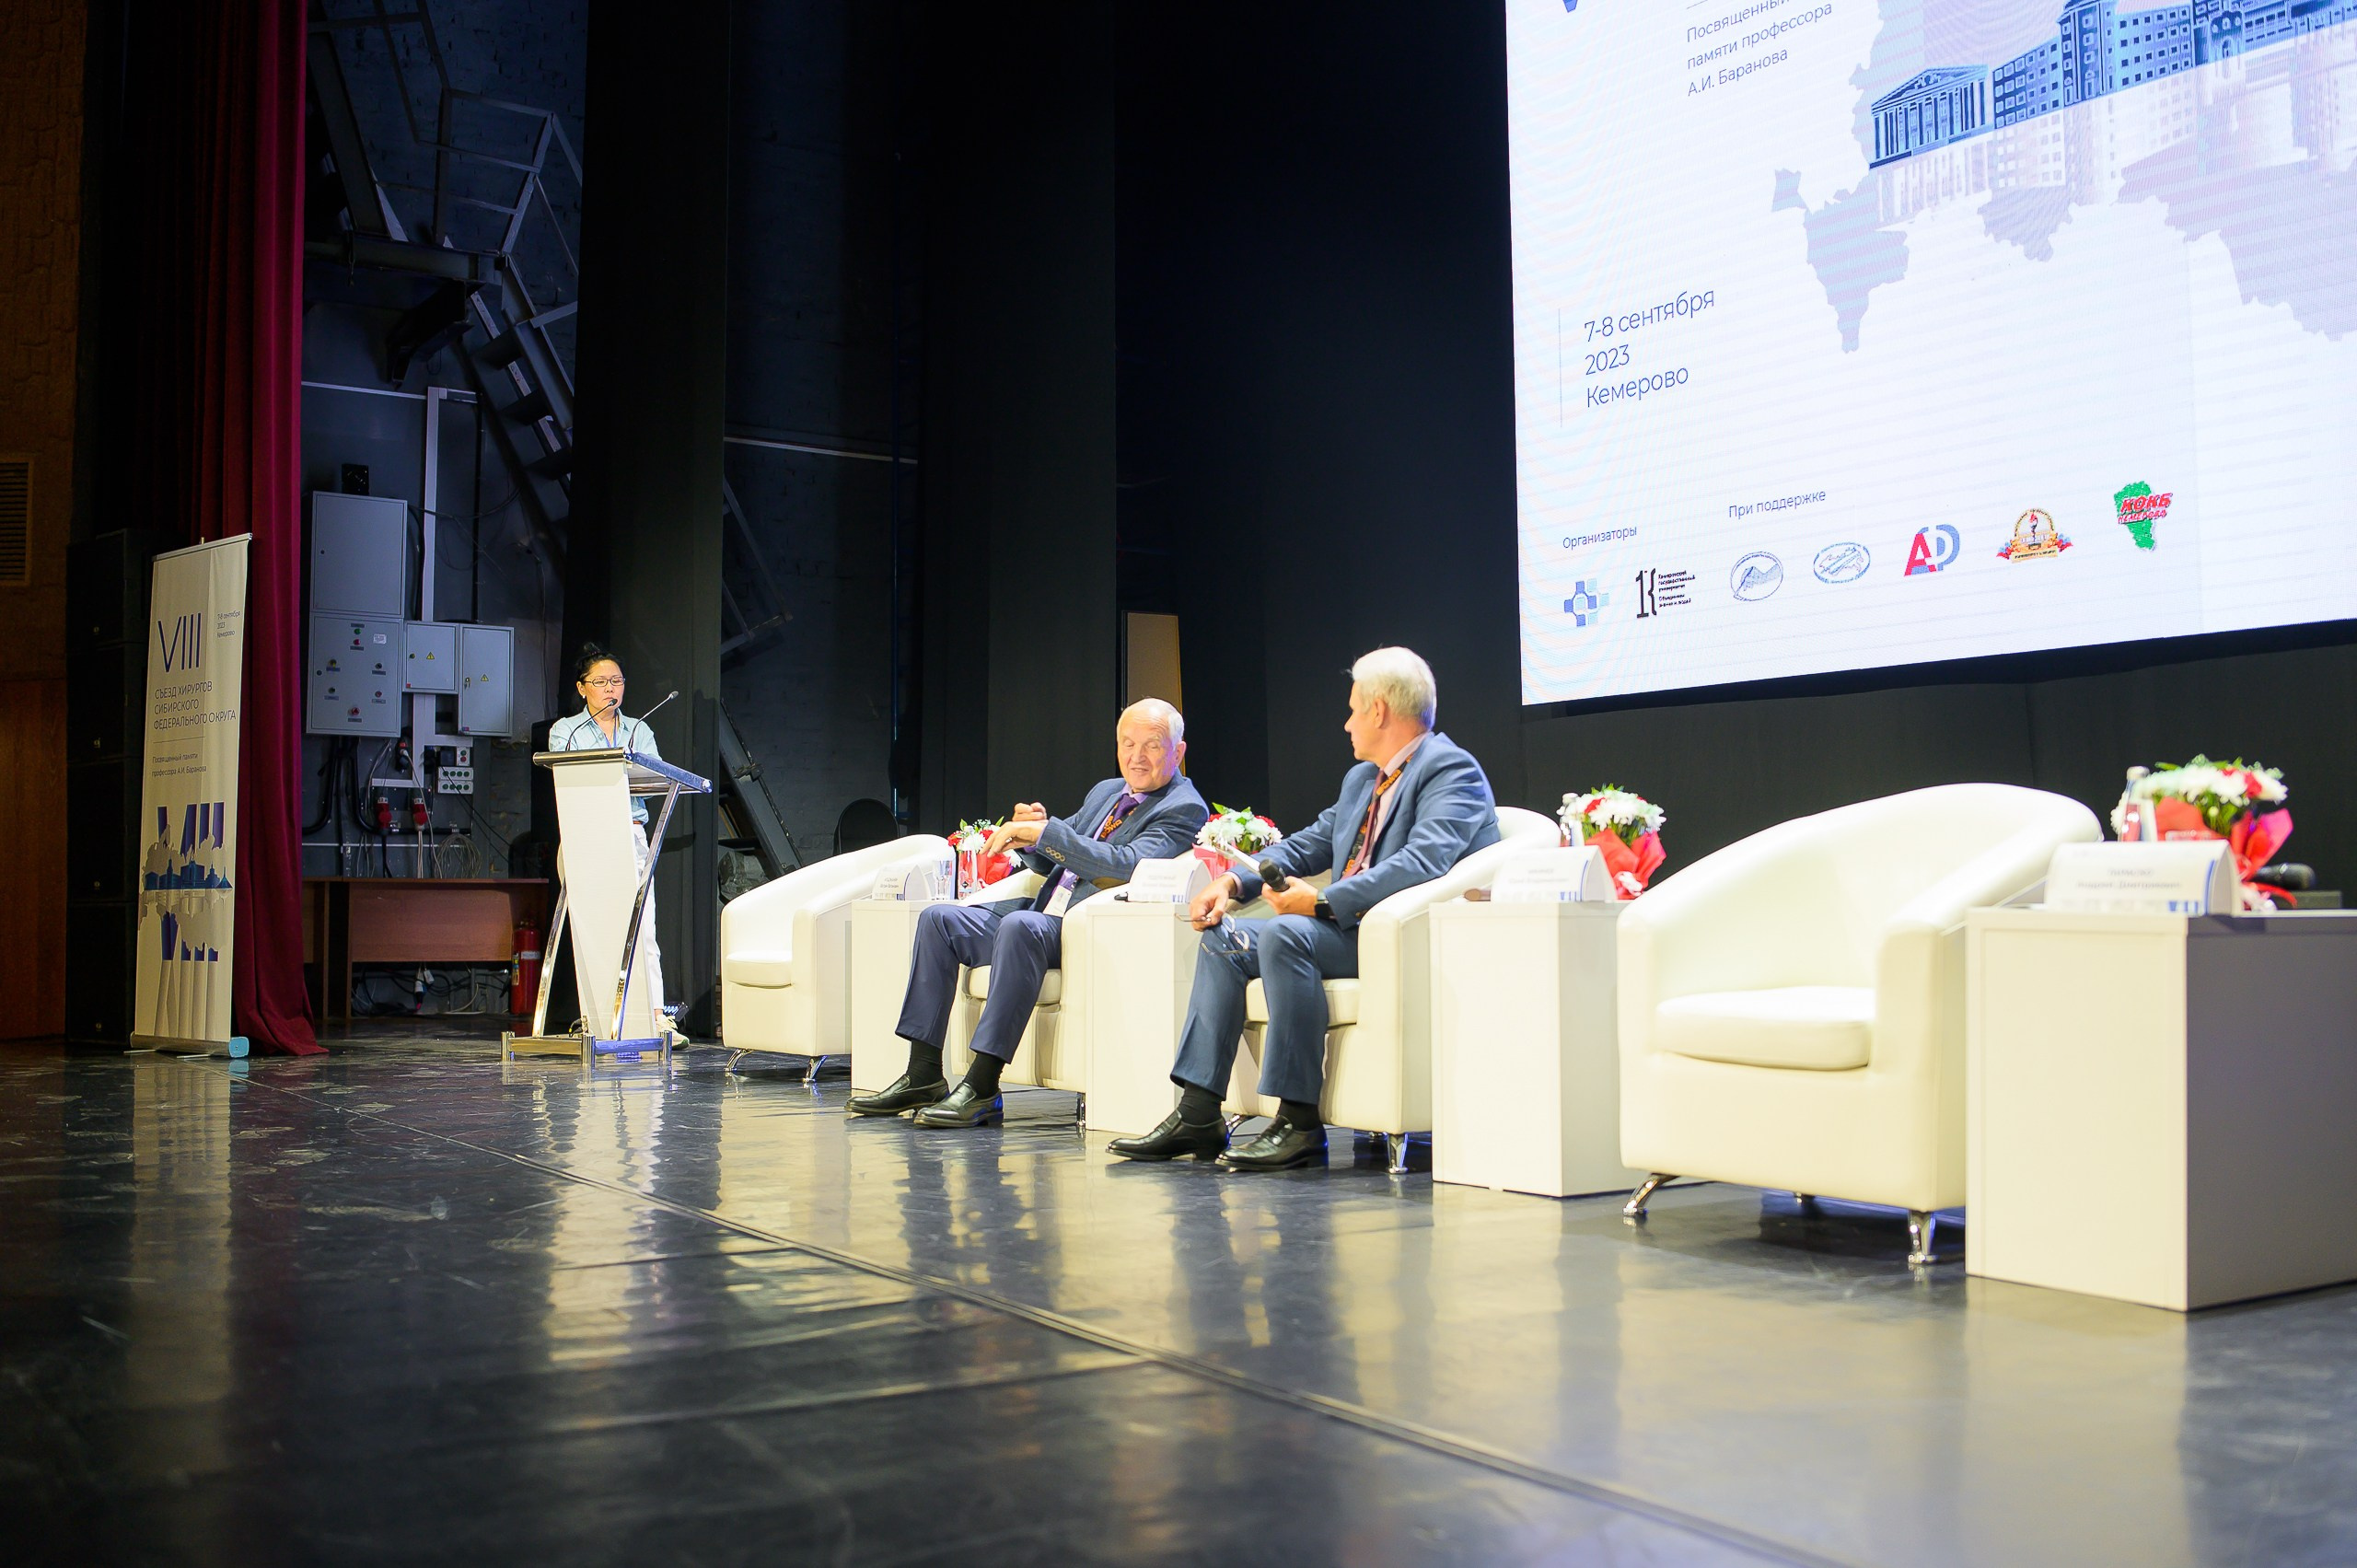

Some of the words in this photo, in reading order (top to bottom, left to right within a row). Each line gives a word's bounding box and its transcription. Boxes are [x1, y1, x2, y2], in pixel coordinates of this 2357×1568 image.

[1687, 0, 1790, 42] Посвященны
[1688, 41, 1737, 70] памяти
[1742, 3, 1832, 48] профессора
[1688, 75, 1714, 97] А.И.
[1718, 49, 1788, 85] Баранова
[1584, 316, 1614, 343] 7-8
[1619, 290, 1714, 332] сентября
[1585, 343, 1630, 376] 2023
[1586, 367, 1689, 408] Кемерово
[1729, 503, 1754, 519] При
[1757, 489, 1827, 514] поддержке
[1562, 525, 1638, 551] Организаторы
[157, 612, 202, 673] VIII
[154, 698, 200, 715] СИБИРСКОГО
[155, 686, 177, 700] СЪЕЗД
[178, 680, 213, 696] ХИРУРГОВ
[153, 713, 208, 731] ФЕДЕРАЛЬНОГО
[208, 710, 237, 723] ОКРУГА
